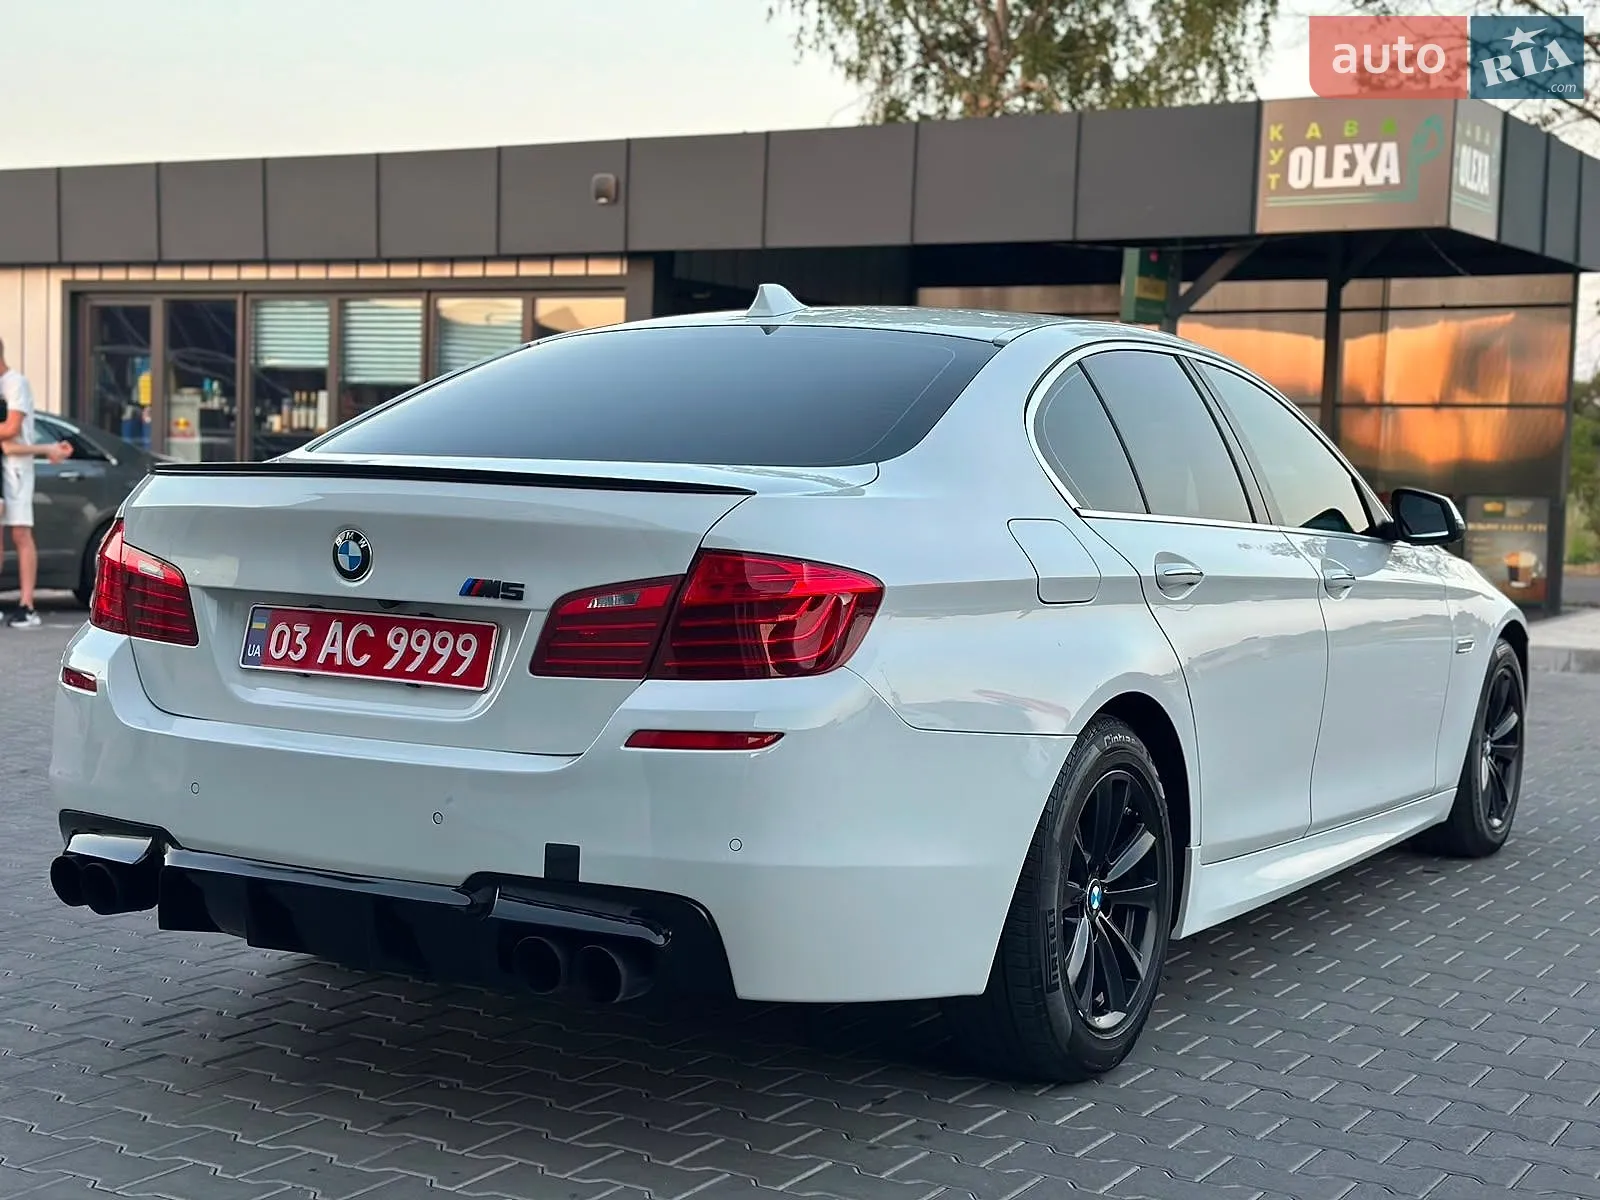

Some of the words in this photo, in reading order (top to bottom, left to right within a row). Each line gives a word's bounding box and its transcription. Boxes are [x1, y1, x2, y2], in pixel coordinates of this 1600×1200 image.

[1288, 142, 1400, 189] OLEXA
[248, 644, 261, 657] UA
[269, 622, 310, 661] 03
[317, 619, 375, 666] AC
[384, 626, 478, 677] 9999
